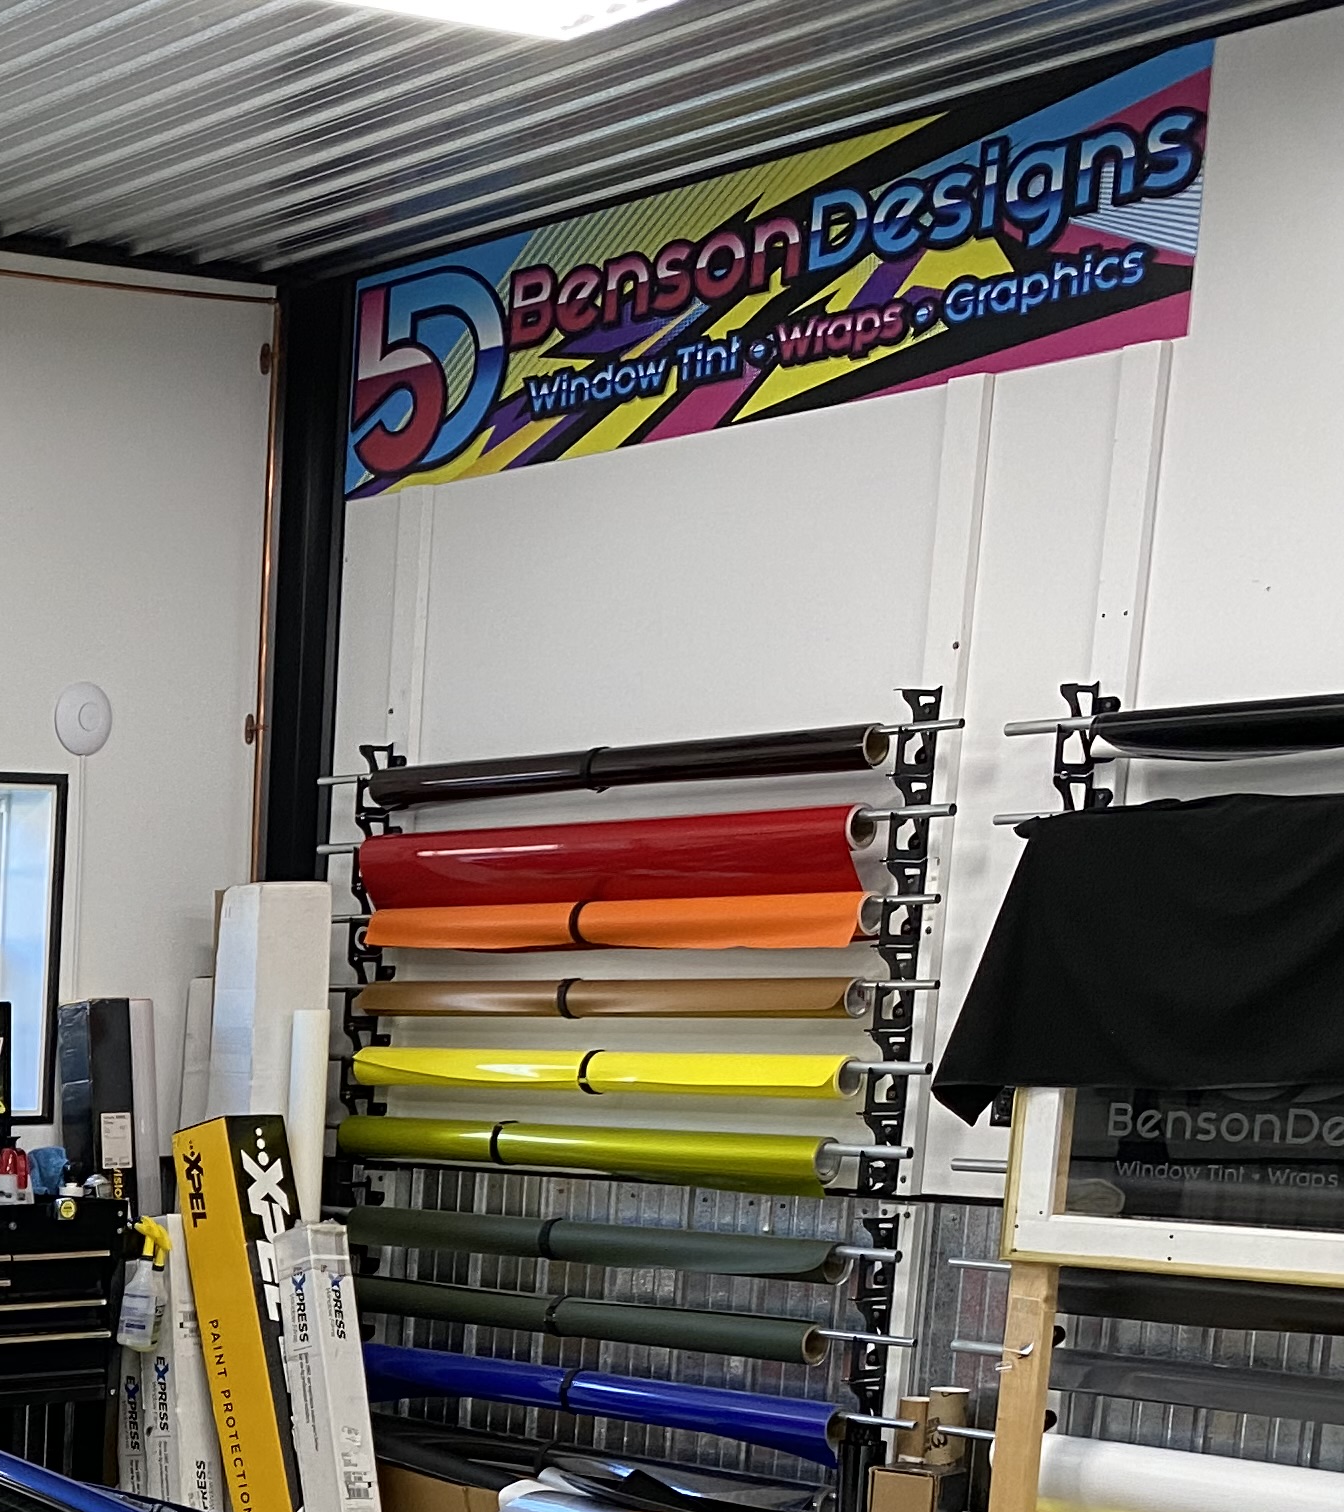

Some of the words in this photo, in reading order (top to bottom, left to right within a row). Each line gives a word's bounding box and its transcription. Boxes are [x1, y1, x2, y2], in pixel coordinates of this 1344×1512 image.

[528, 353, 669, 415] Window
[677, 337, 742, 384] Tint
[775, 298, 908, 364] Wraps
[945, 244, 1147, 327] Graphics
[182, 1153, 208, 1228] XPEL
[1116, 1160, 1200, 1182] Window
[1207, 1164, 1245, 1183] Tint
[1267, 1167, 1339, 1190] Wraps
[240, 1149, 291, 1322] XPEL
[328, 1271, 347, 1340] XPRESS
[207, 1320, 228, 1378] PAINT
[125, 1375, 141, 1451] EXPRESS
[154, 1356, 170, 1431] EXPRESS
